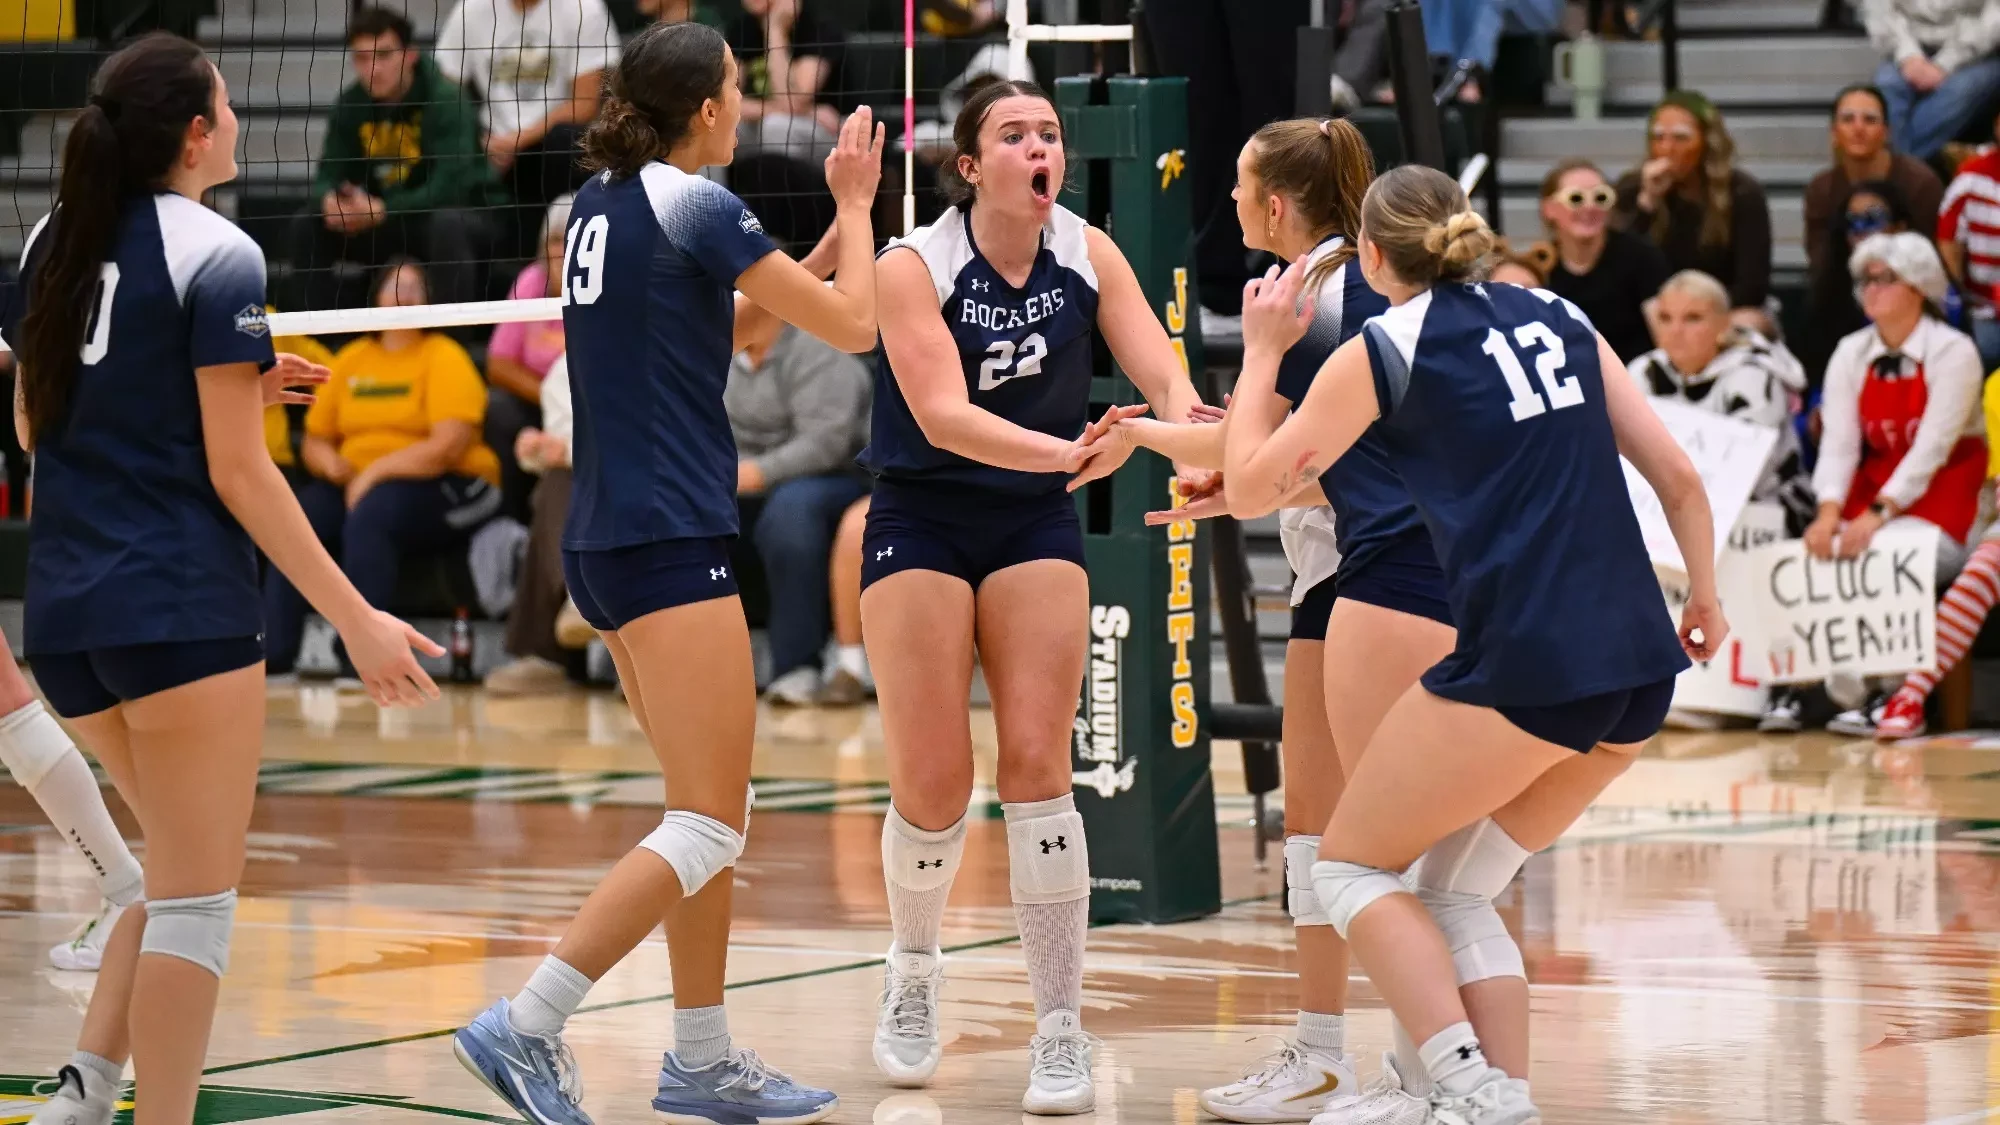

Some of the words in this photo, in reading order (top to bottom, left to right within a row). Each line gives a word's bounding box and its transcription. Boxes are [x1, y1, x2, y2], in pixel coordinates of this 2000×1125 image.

[561, 214, 609, 305] 19
[961, 287, 1064, 331] ROCKERS
[978, 332, 1048, 391] 22
[1481, 321, 1586, 423] 12
[1165, 268, 1198, 747] JKETS
[1770, 549, 1924, 608] CLUCK
[1091, 605, 1131, 762] STADIUM
